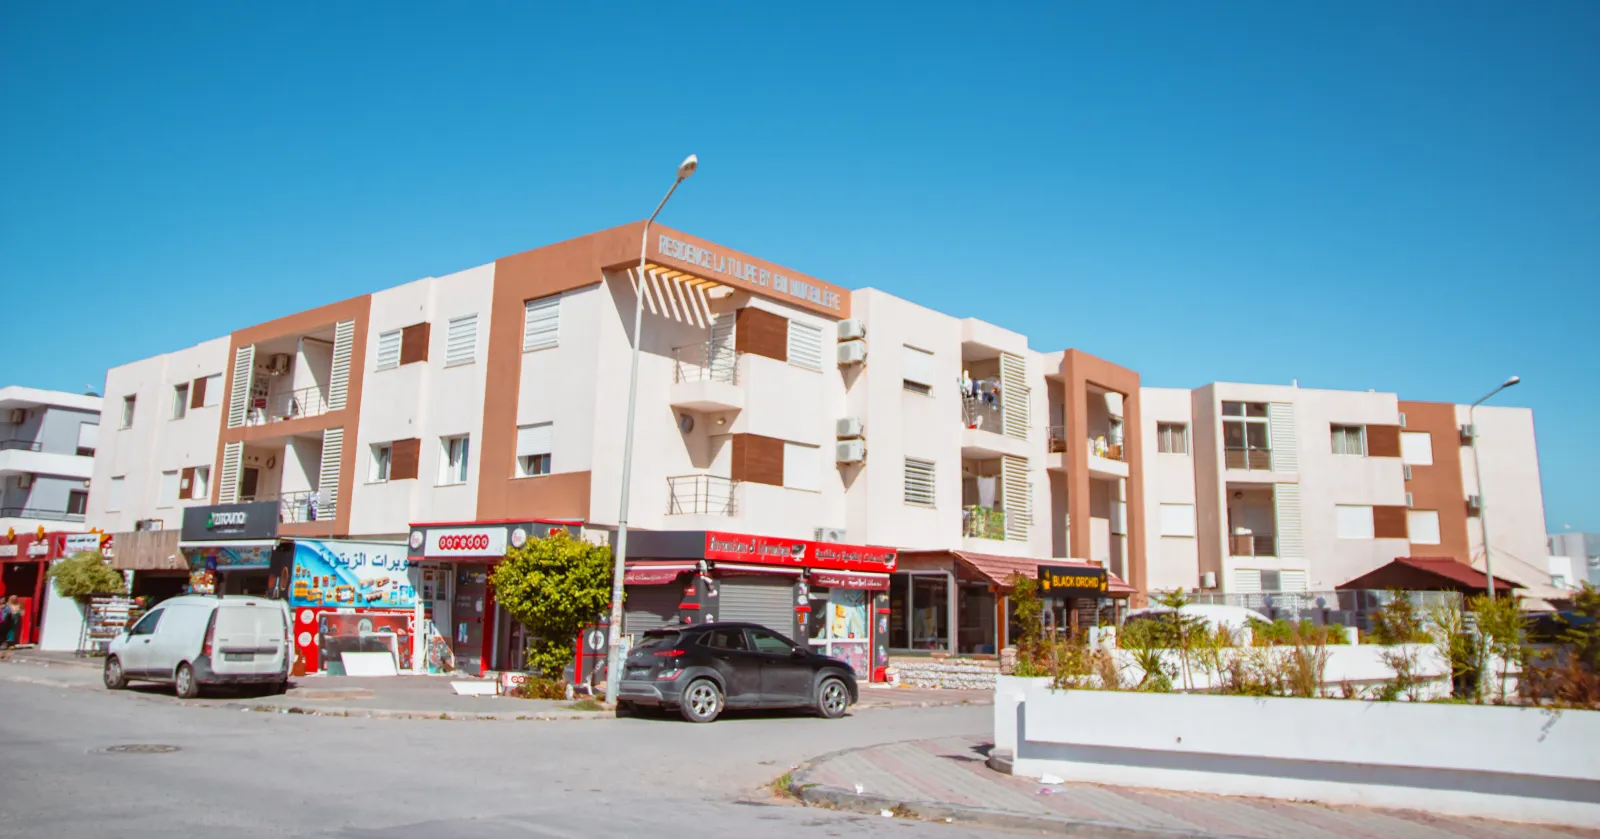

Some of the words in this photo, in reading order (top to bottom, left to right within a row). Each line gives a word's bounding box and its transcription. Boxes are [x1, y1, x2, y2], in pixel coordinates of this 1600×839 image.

[659, 234, 712, 269] RESIDENCE
[713, 252, 726, 273] LA
[727, 257, 758, 284] TULIPE
[760, 268, 771, 288] BY
[438, 534, 490, 551] ooredoo
[1052, 575, 1075, 587] BLACK
[1075, 576, 1099, 588] ORCHID
